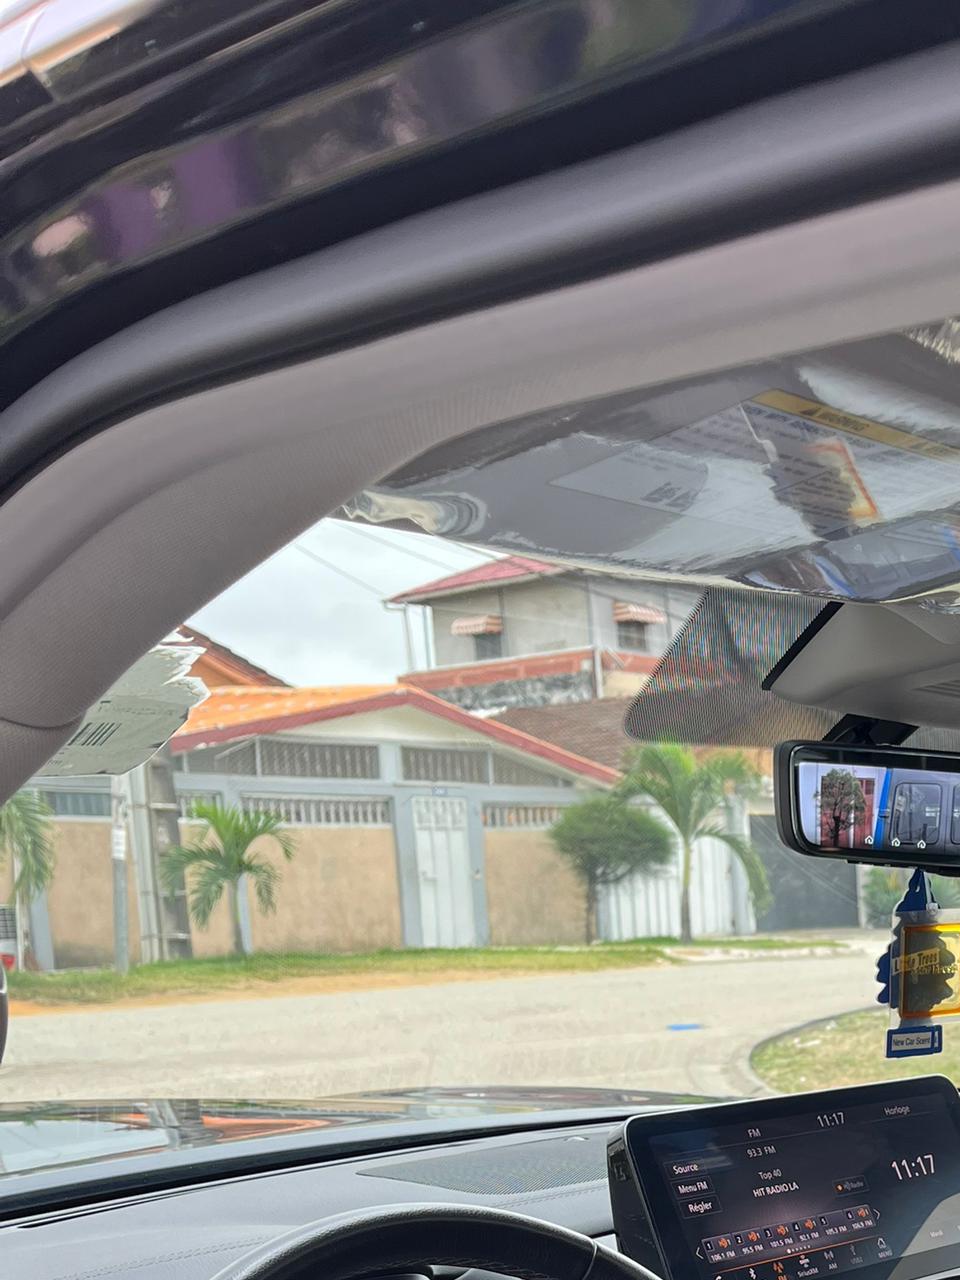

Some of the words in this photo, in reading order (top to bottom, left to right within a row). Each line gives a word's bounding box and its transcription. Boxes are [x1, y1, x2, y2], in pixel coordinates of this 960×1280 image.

[893, 1038, 905, 1047] New
[905, 1037, 915, 1046] Car
[817, 1112, 846, 1128] 11:17
[748, 1128, 762, 1138] FM
[747, 1148, 762, 1158] 93.3
[764, 1146, 777, 1155] FM
[672, 1164, 699, 1175] Source
[891, 1154, 936, 1180] 11:17
[758, 1171, 773, 1181] Top
[678, 1185, 698, 1194] Menu
[697, 1181, 708, 1191] FM
[753, 1188, 765, 1198] HIT
[766, 1184, 789, 1195] RADIO
[788, 1181, 799, 1191] LA
[688, 1201, 713, 1213] Régler
